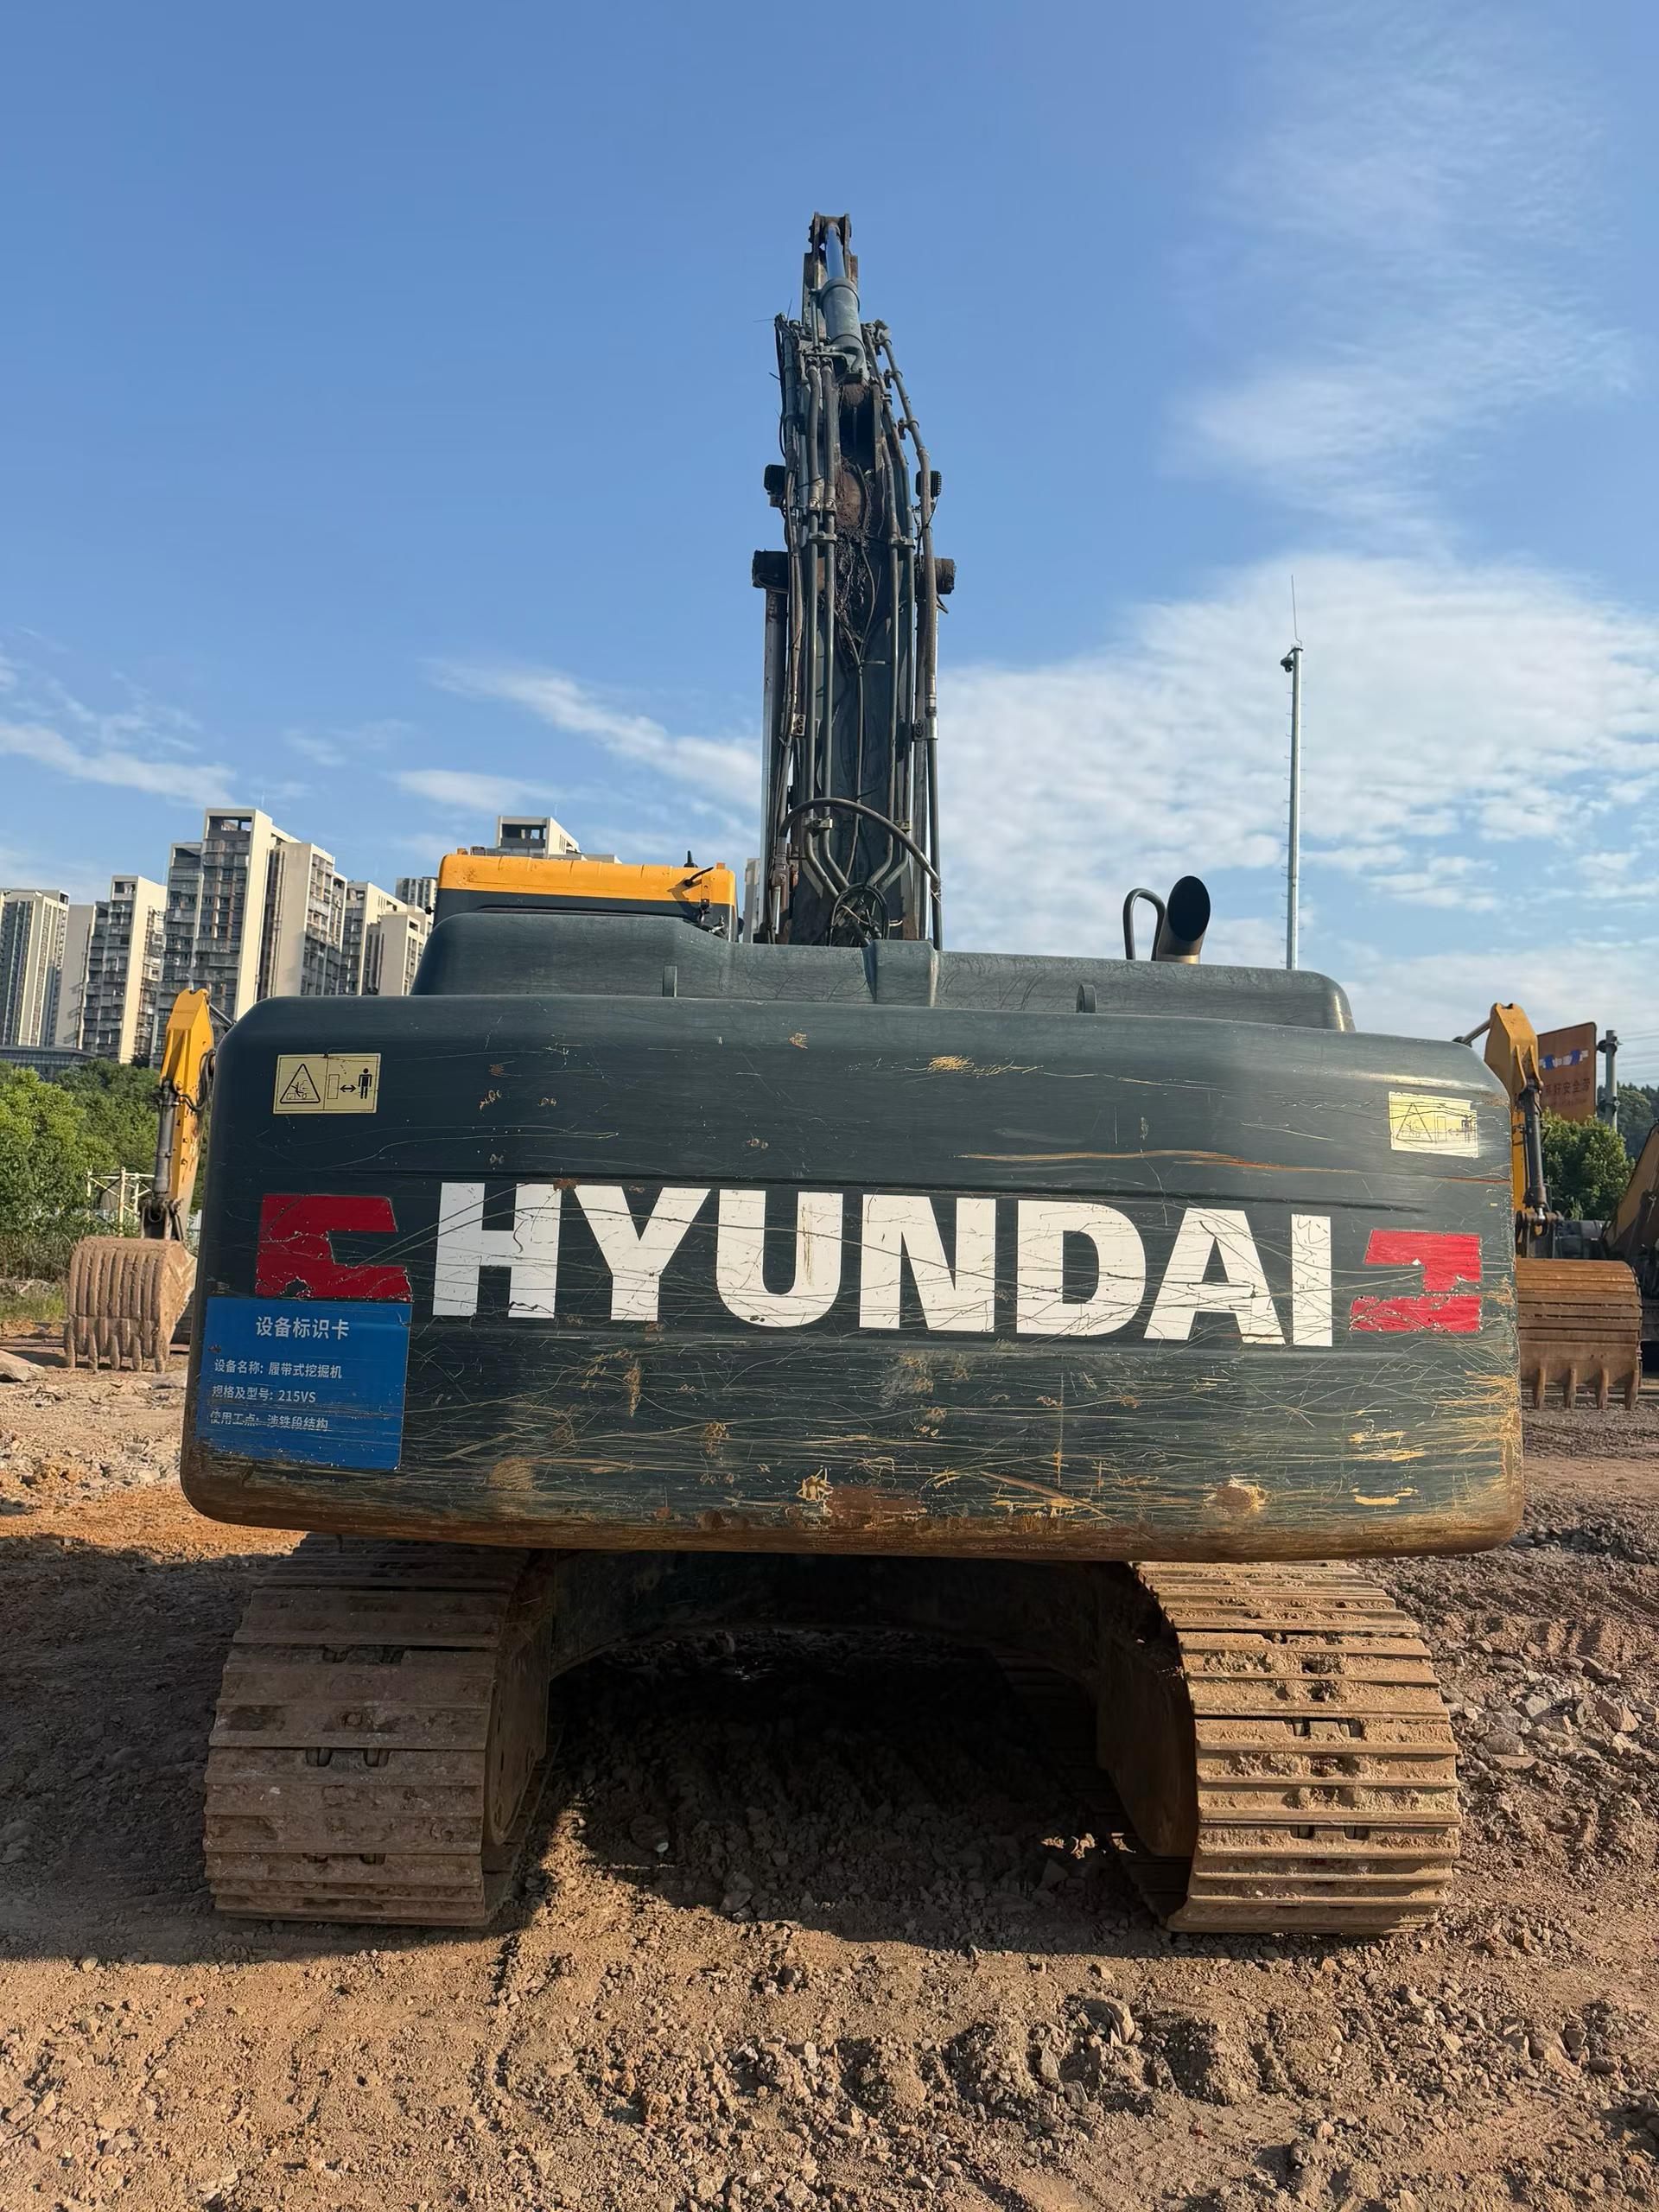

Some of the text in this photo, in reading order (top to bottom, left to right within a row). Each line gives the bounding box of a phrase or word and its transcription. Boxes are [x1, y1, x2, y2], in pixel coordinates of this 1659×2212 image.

[433, 1182, 1332, 1347] HYUNDAI
[256, 1316, 350, 1340] 设备标识卡
